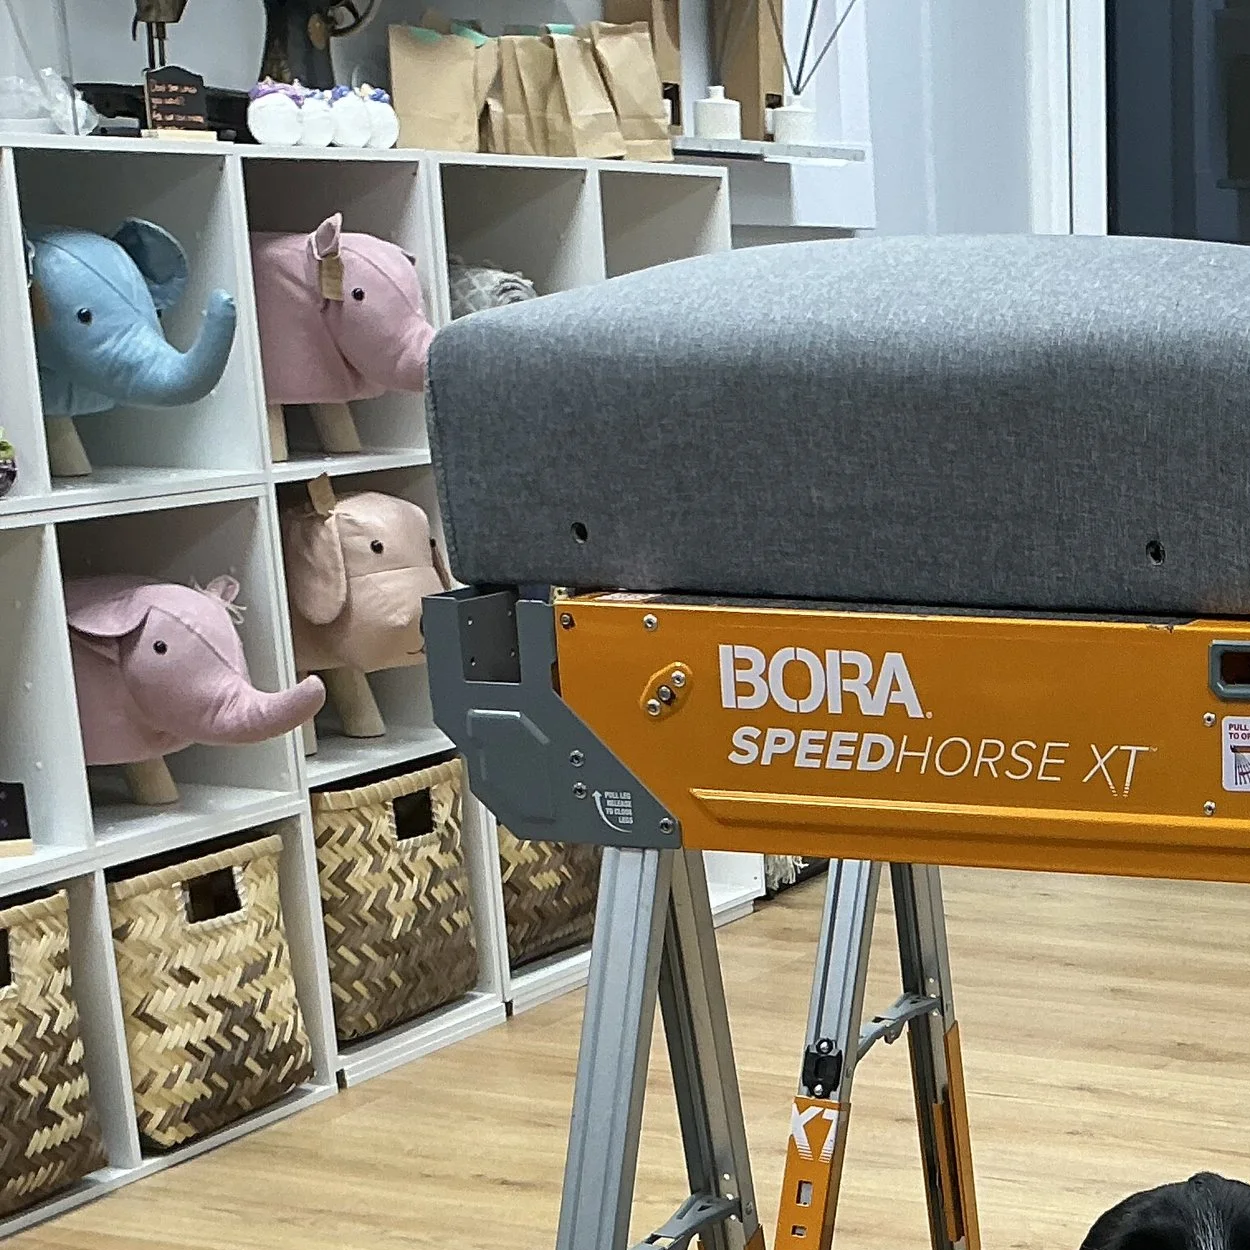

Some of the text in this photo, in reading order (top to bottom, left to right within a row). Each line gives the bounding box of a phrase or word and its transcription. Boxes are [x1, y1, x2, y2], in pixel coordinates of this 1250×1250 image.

[718, 644, 925, 718] BORA
[1228, 723, 1249, 732] PULL
[1228, 732, 1240, 740] TO
[727, 725, 1150, 798] SPEEDHORSE XT
